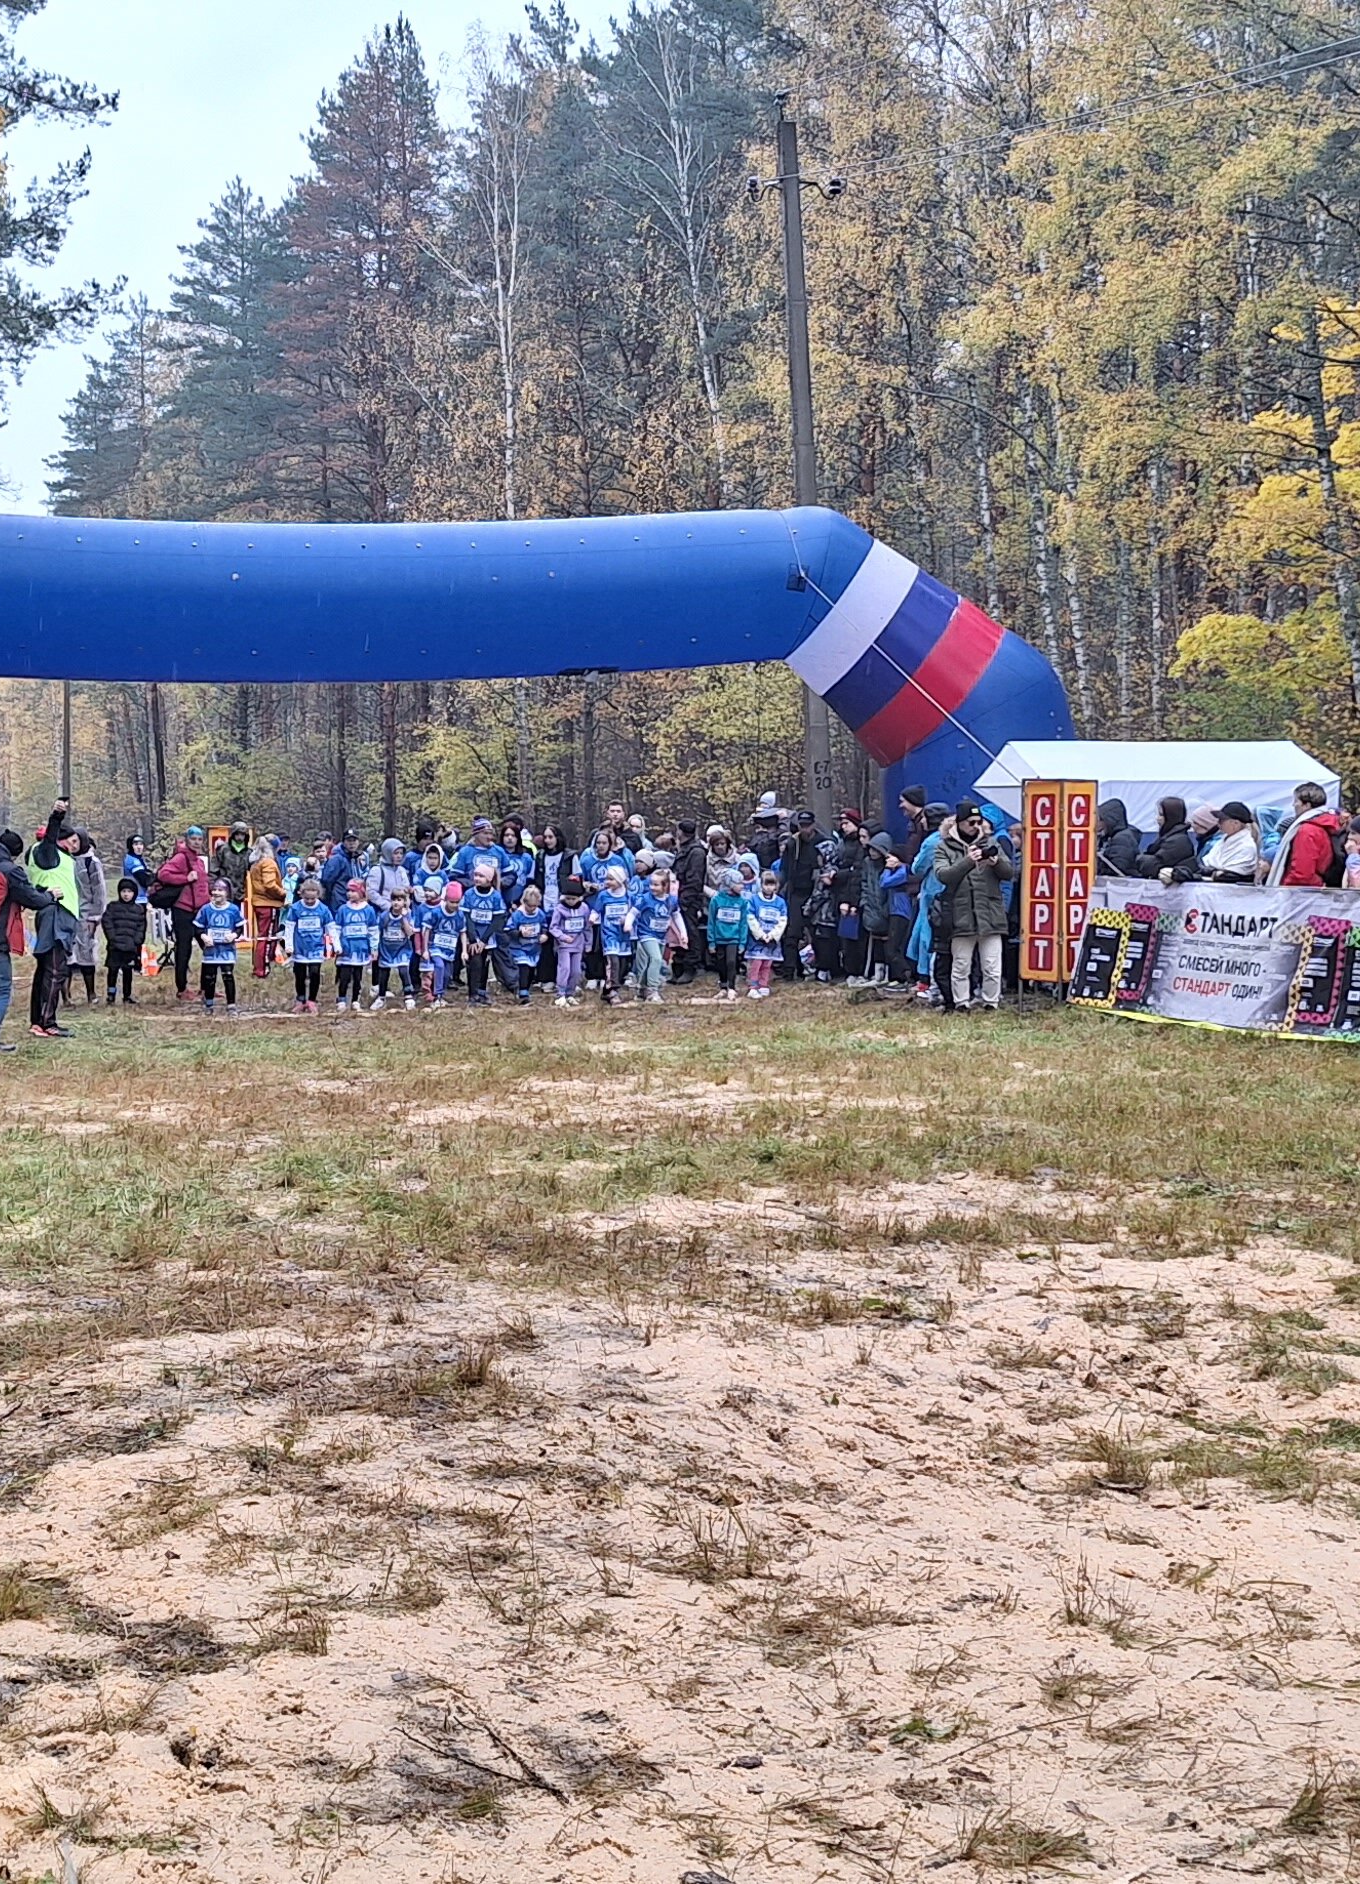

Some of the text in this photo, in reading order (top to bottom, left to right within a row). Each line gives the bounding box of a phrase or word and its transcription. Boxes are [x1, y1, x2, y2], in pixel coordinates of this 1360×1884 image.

[814, 776, 832, 790] 20
[1033, 796, 1052, 969] СТАРТ
[1183, 908, 1279, 939] СТАНДАРТ
[1178, 955, 1224, 974] СМЕСЕЙ
[1224, 960, 1262, 977] МНОГО
[1173, 976, 1264, 1001] СТАНДАРТ ОДИН!
